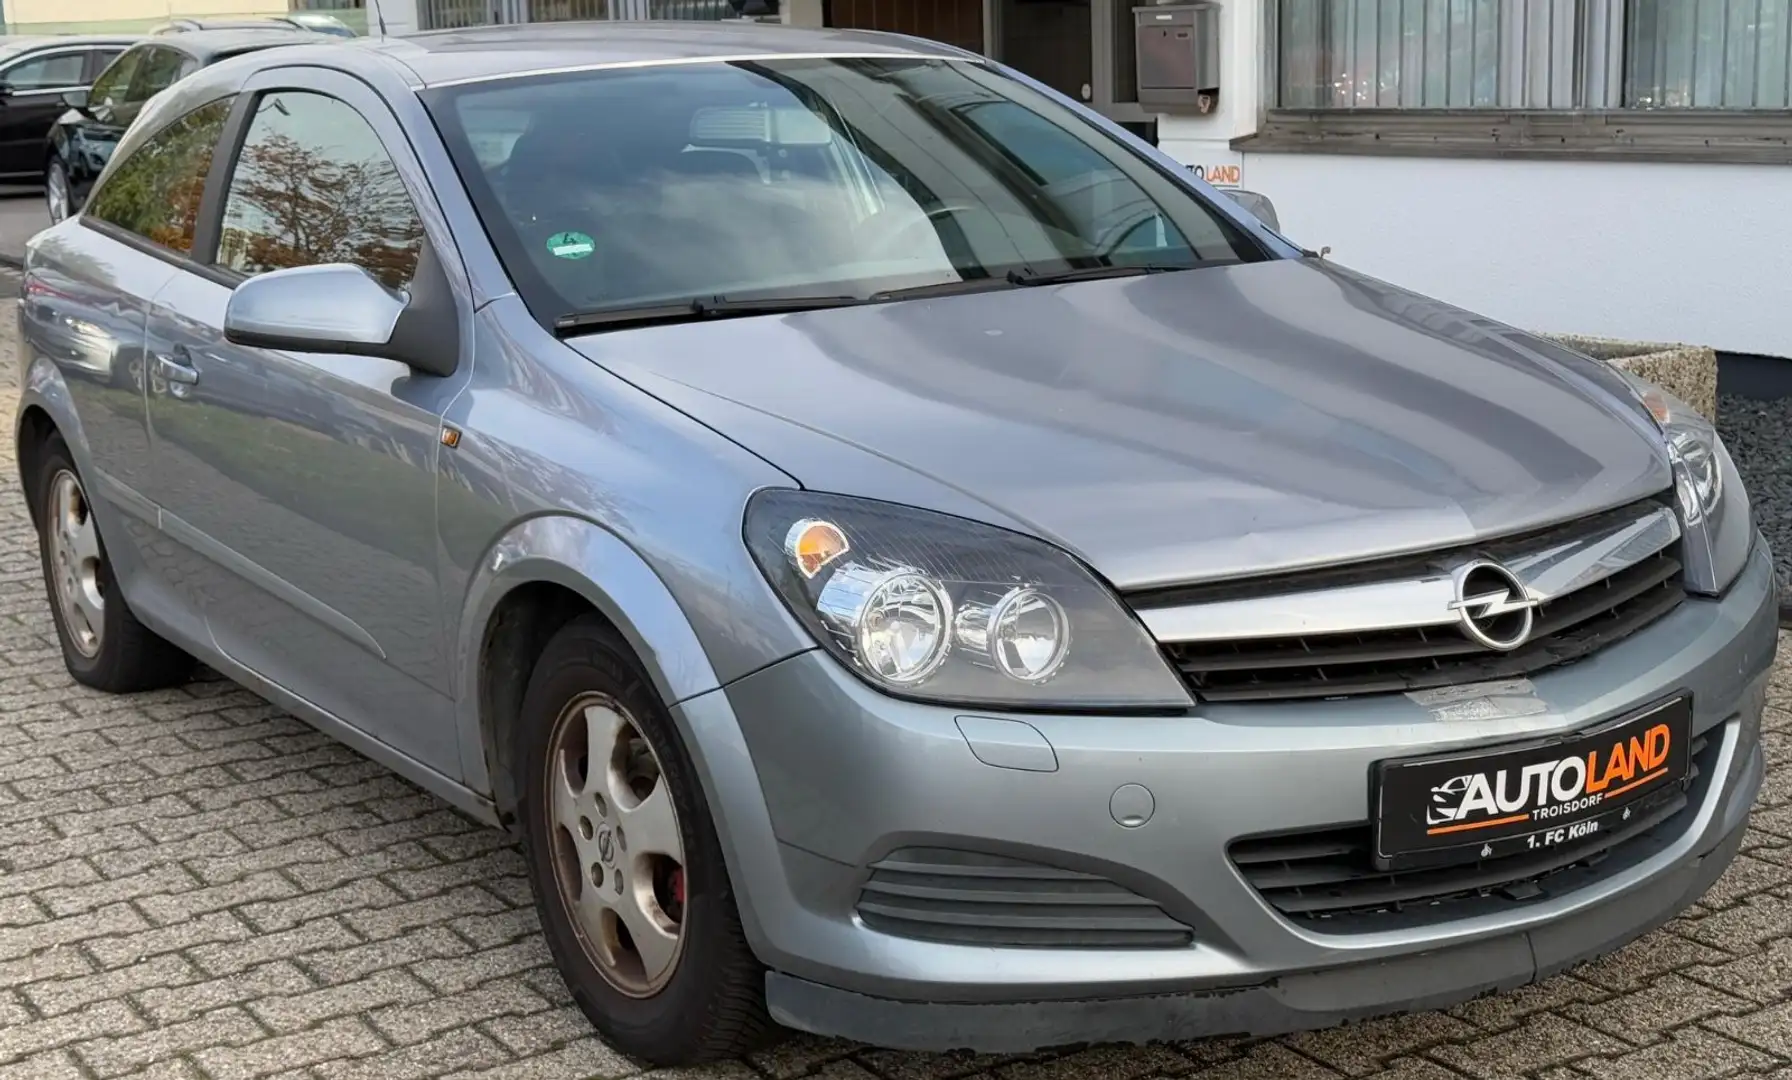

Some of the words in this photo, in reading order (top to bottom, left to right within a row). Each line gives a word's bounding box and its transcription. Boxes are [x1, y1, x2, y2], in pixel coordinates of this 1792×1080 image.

[1185, 164, 1240, 183] TOLAND
[1454, 723, 1670, 820] AUTOLAND
[1532, 792, 1603, 821] TROISDORF
[1527, 835, 1540, 848] 1.
[1545, 830, 1565, 846] FC
[1568, 821, 1599, 840] Köln
